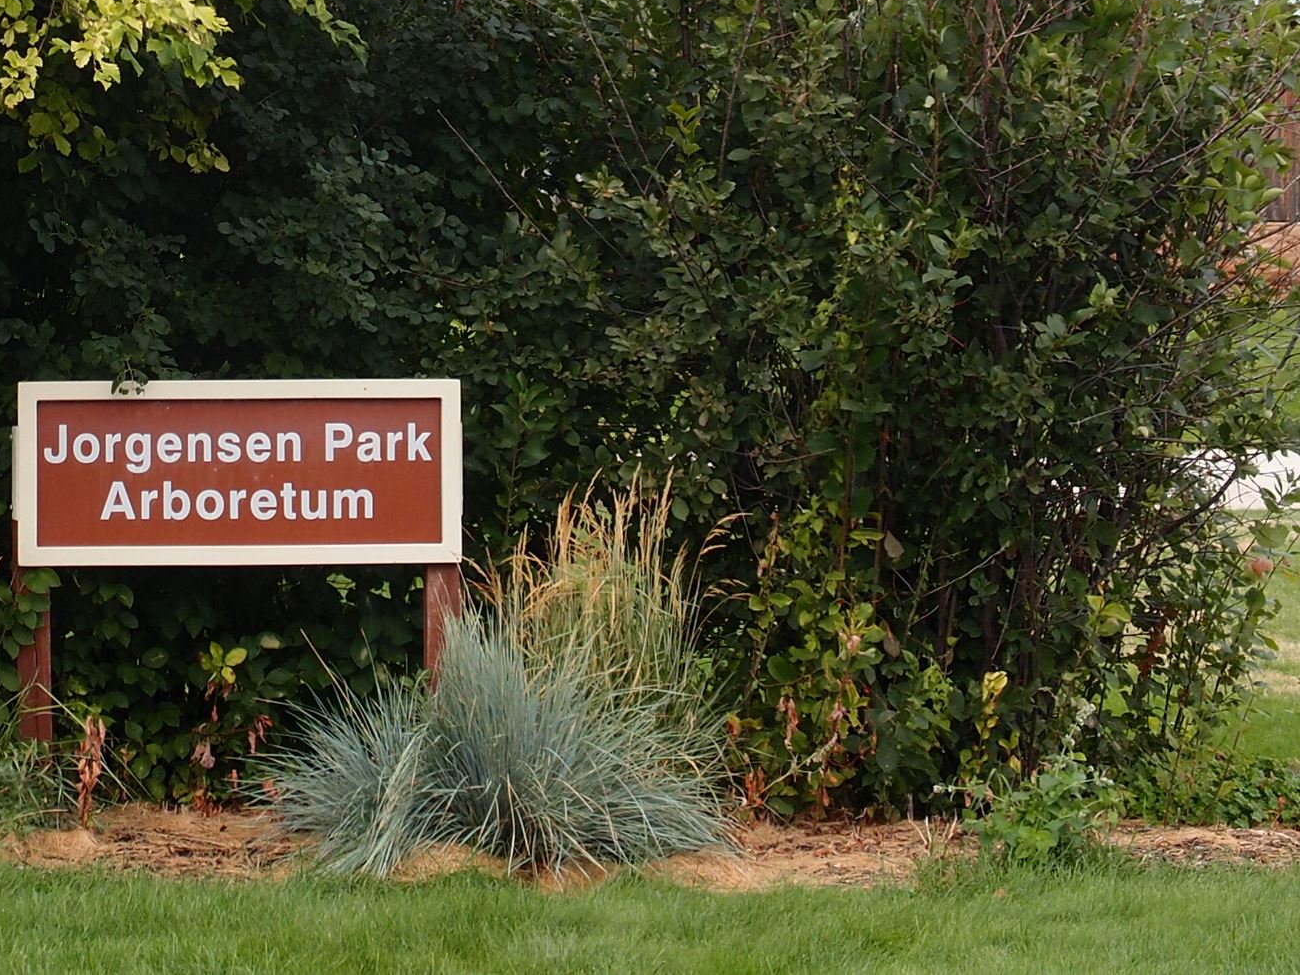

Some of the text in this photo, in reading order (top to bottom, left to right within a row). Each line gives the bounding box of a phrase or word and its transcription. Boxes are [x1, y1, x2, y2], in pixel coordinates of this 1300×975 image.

[43, 422, 432, 474] Jorgensen Park
[100, 481, 374, 520] Arboretum
